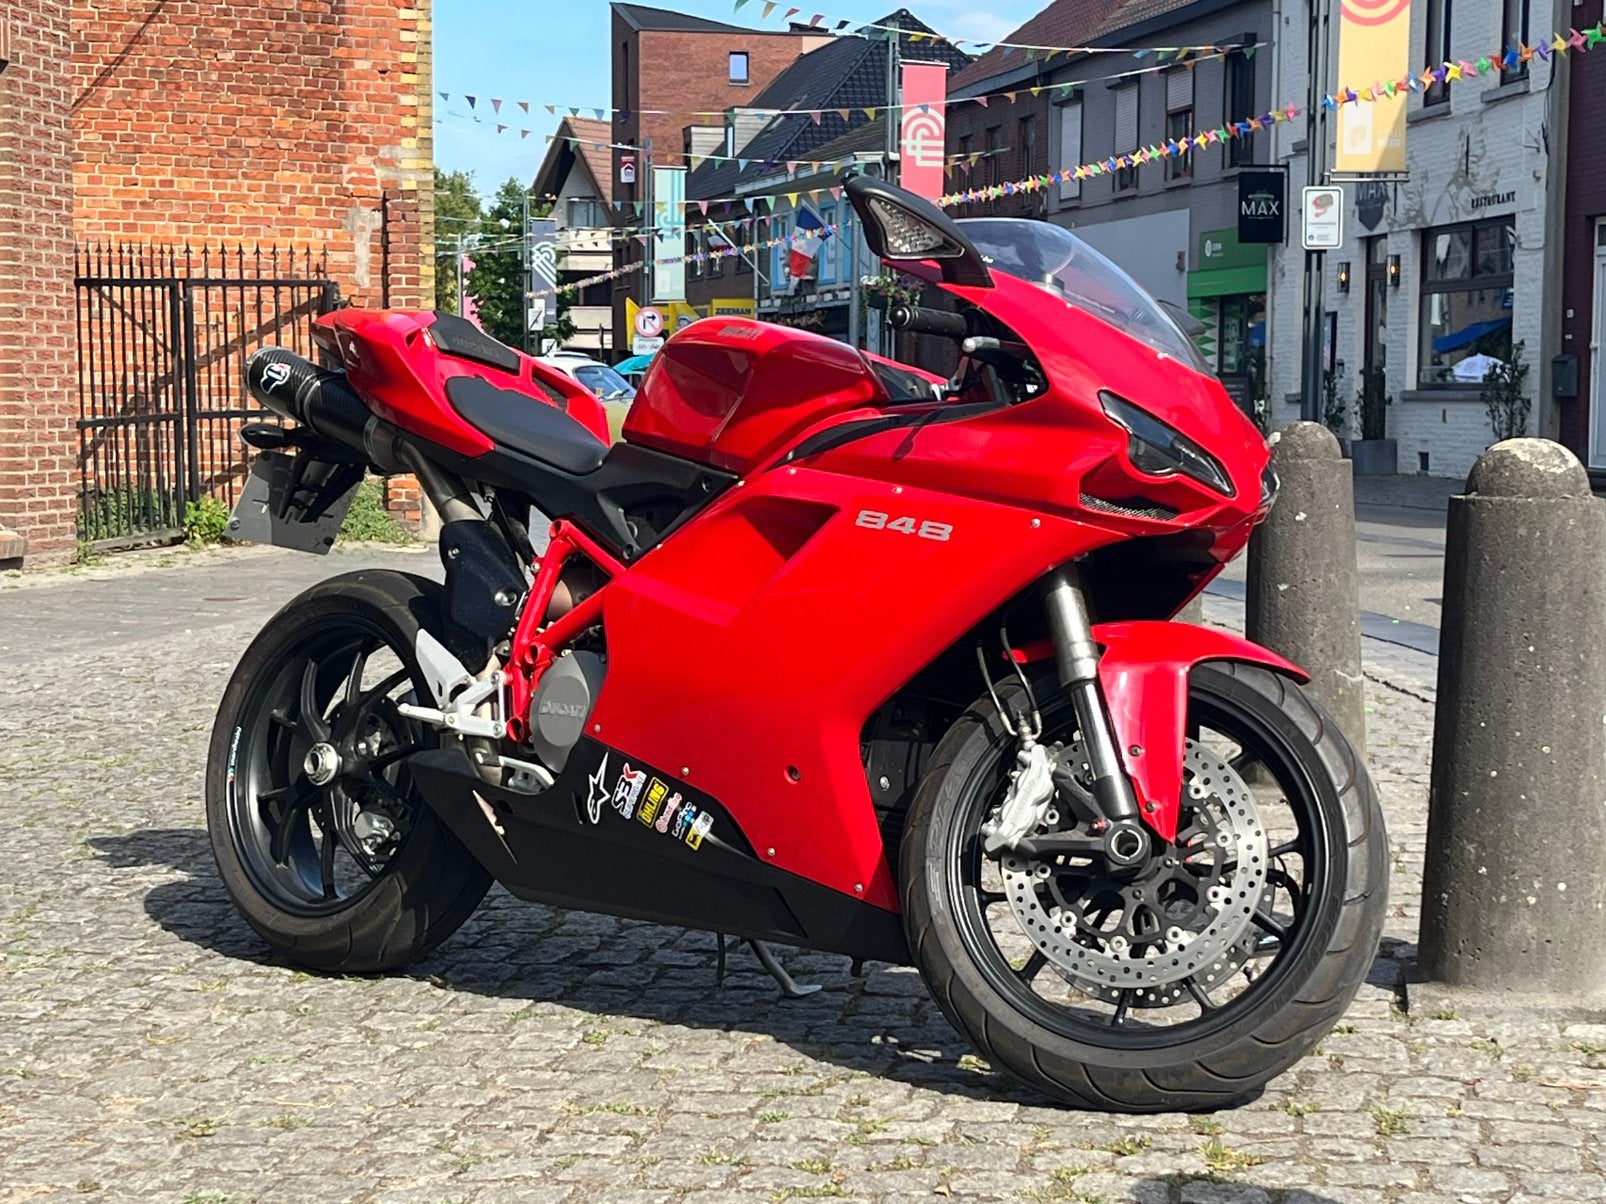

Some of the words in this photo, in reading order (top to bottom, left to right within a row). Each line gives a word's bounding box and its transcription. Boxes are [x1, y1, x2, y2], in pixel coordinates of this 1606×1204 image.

[1241, 200, 1280, 216] MAX
[715, 307, 752, 316] ZEEMAN
[855, 509, 954, 542] 848
[541, 700, 587, 719] DUCATI
